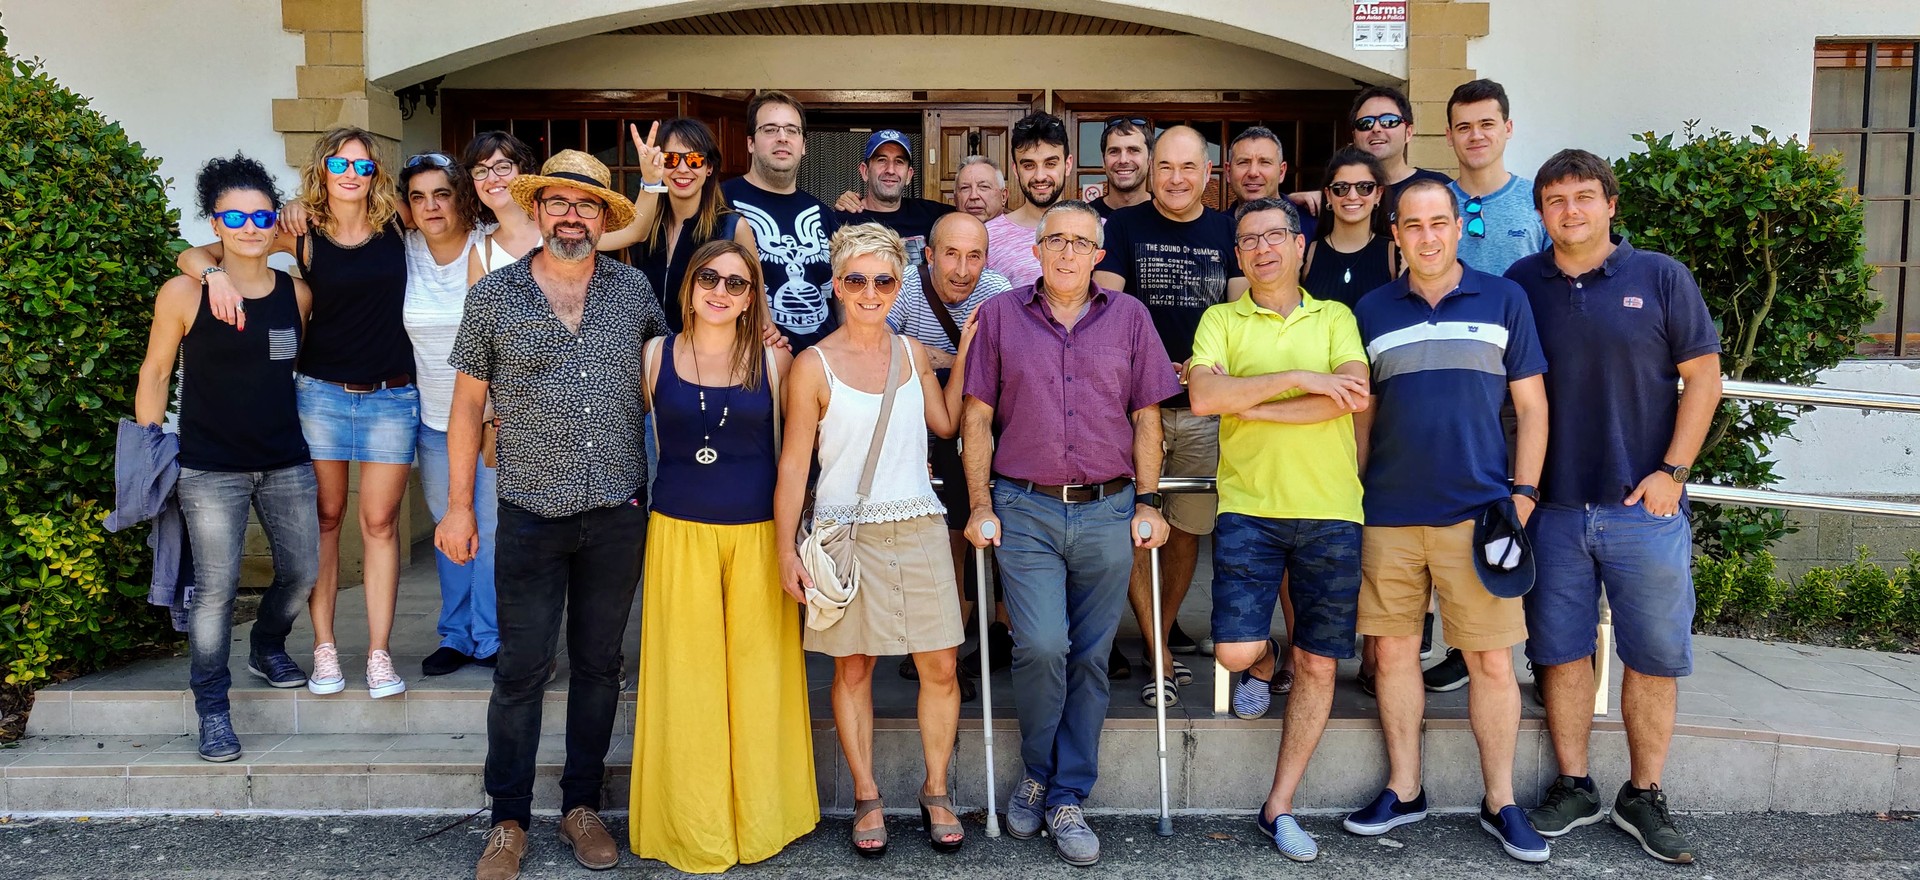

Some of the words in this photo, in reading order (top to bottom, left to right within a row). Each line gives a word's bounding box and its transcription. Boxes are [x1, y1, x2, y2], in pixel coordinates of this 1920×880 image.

[1355, 4, 1405, 15] Alarma
[1146, 243, 1158, 251] THE
[1160, 244, 1181, 252] SOUND
[776, 311, 825, 324] UNSC
